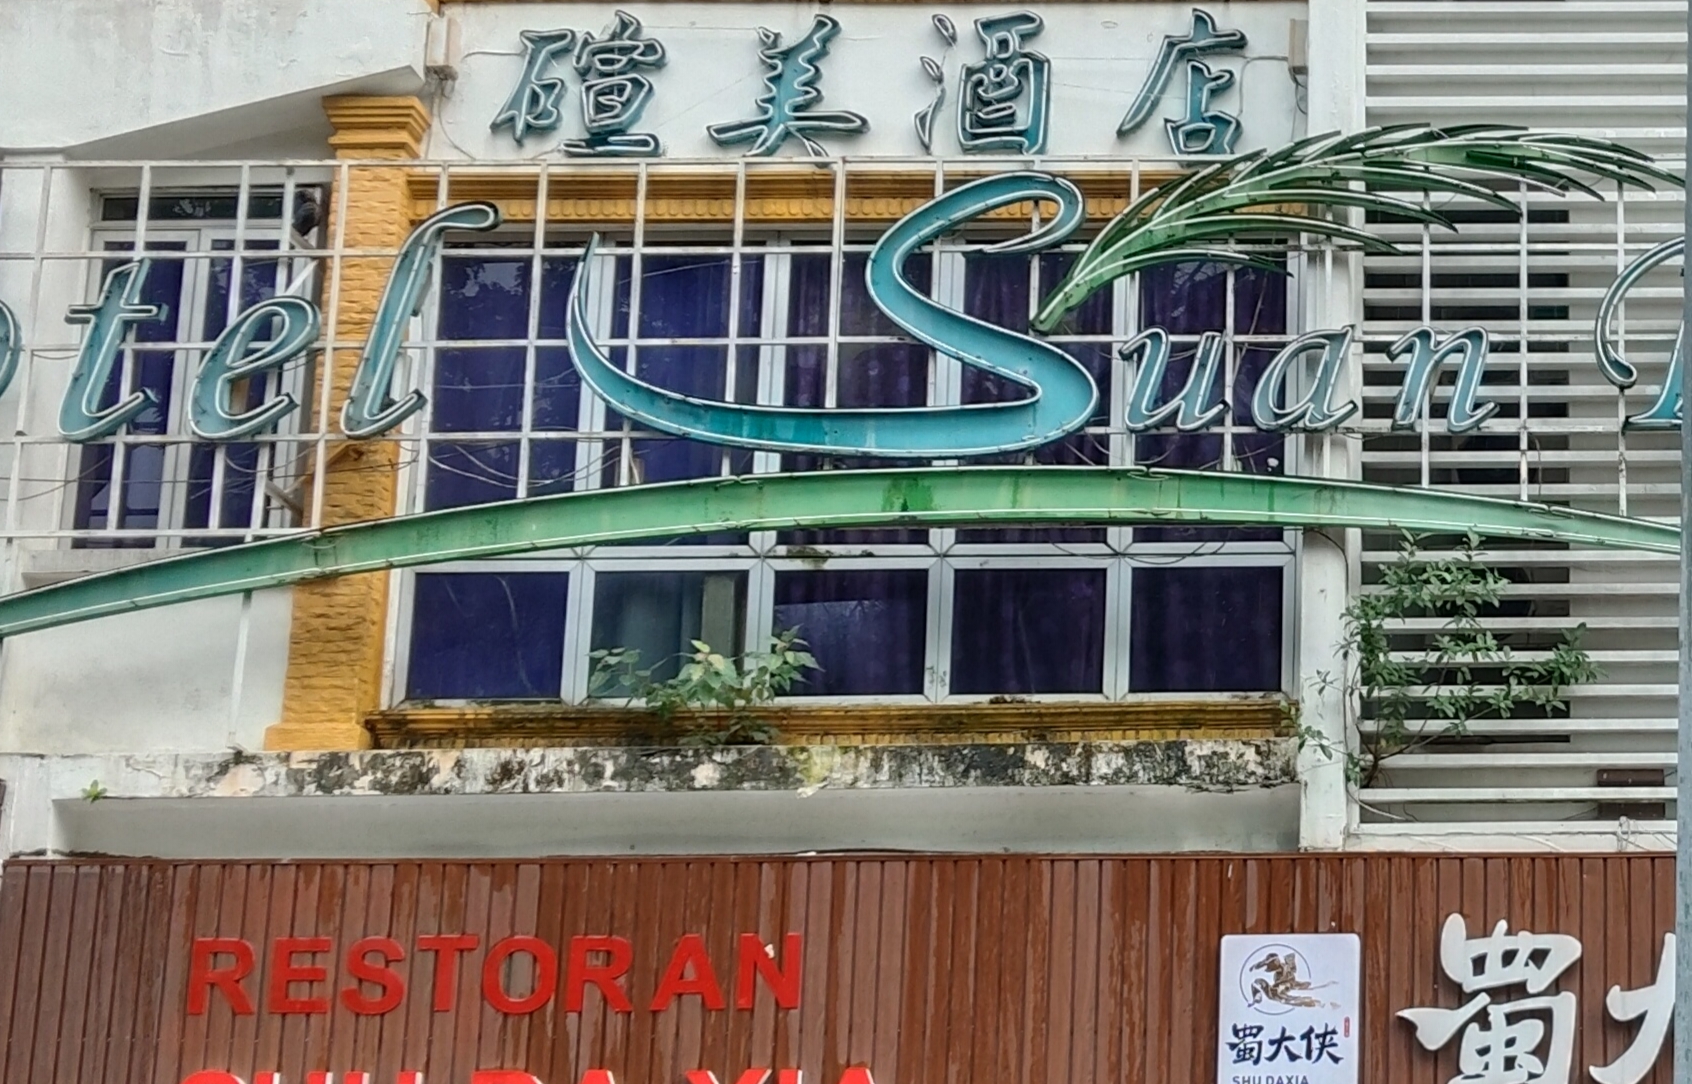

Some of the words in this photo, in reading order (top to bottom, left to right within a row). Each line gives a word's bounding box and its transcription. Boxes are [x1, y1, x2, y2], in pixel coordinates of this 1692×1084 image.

[0, 202, 500, 442] tel
[566, 170, 1499, 458] Suan
[187, 932, 801, 1016] RESTORAN
[1226, 1022, 1345, 1066] 蜀大侠
